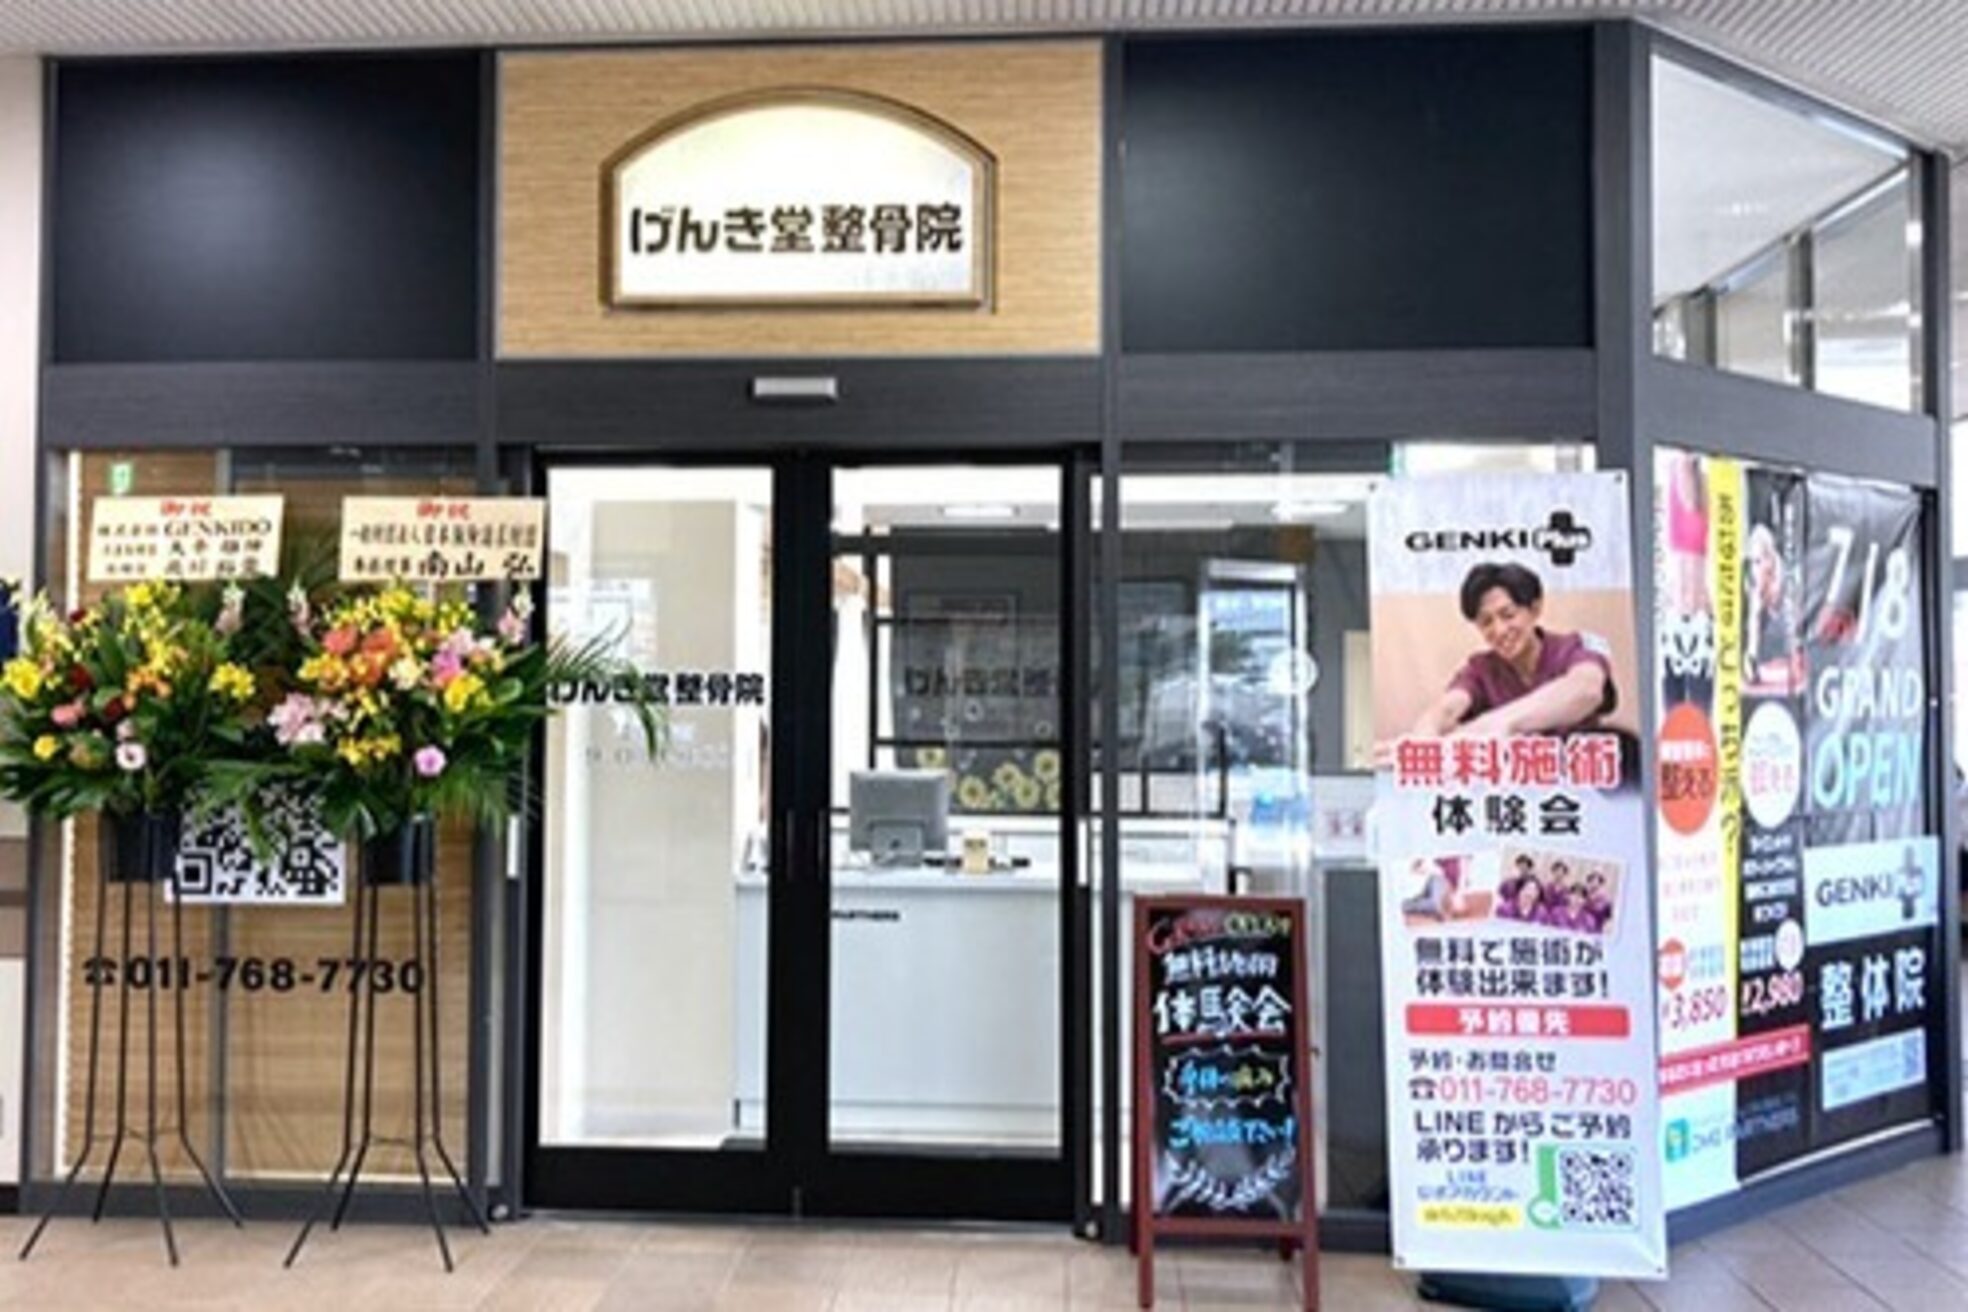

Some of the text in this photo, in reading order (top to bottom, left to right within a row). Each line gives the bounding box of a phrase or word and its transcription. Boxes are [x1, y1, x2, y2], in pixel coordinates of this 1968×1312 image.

[630, 203, 963, 254] げんき堂整骨院
[1405, 529, 1528, 552] GENKI
[1816, 666, 1922, 719] GRAND
[1398, 738, 1619, 786] 無料施術
[1814, 732, 1921, 809] OPEN
[1432, 794, 1582, 836] 体験会
[1815, 877, 1893, 907] GENKI
[1414, 937, 1603, 967] 無料で施術が
[1153, 984, 1292, 1037] 体験会
[1820, 947, 1925, 1031] 整体院
[1440, 1076, 1638, 1107] 011-768-7730
[1415, 1110, 1486, 1135] LINE
